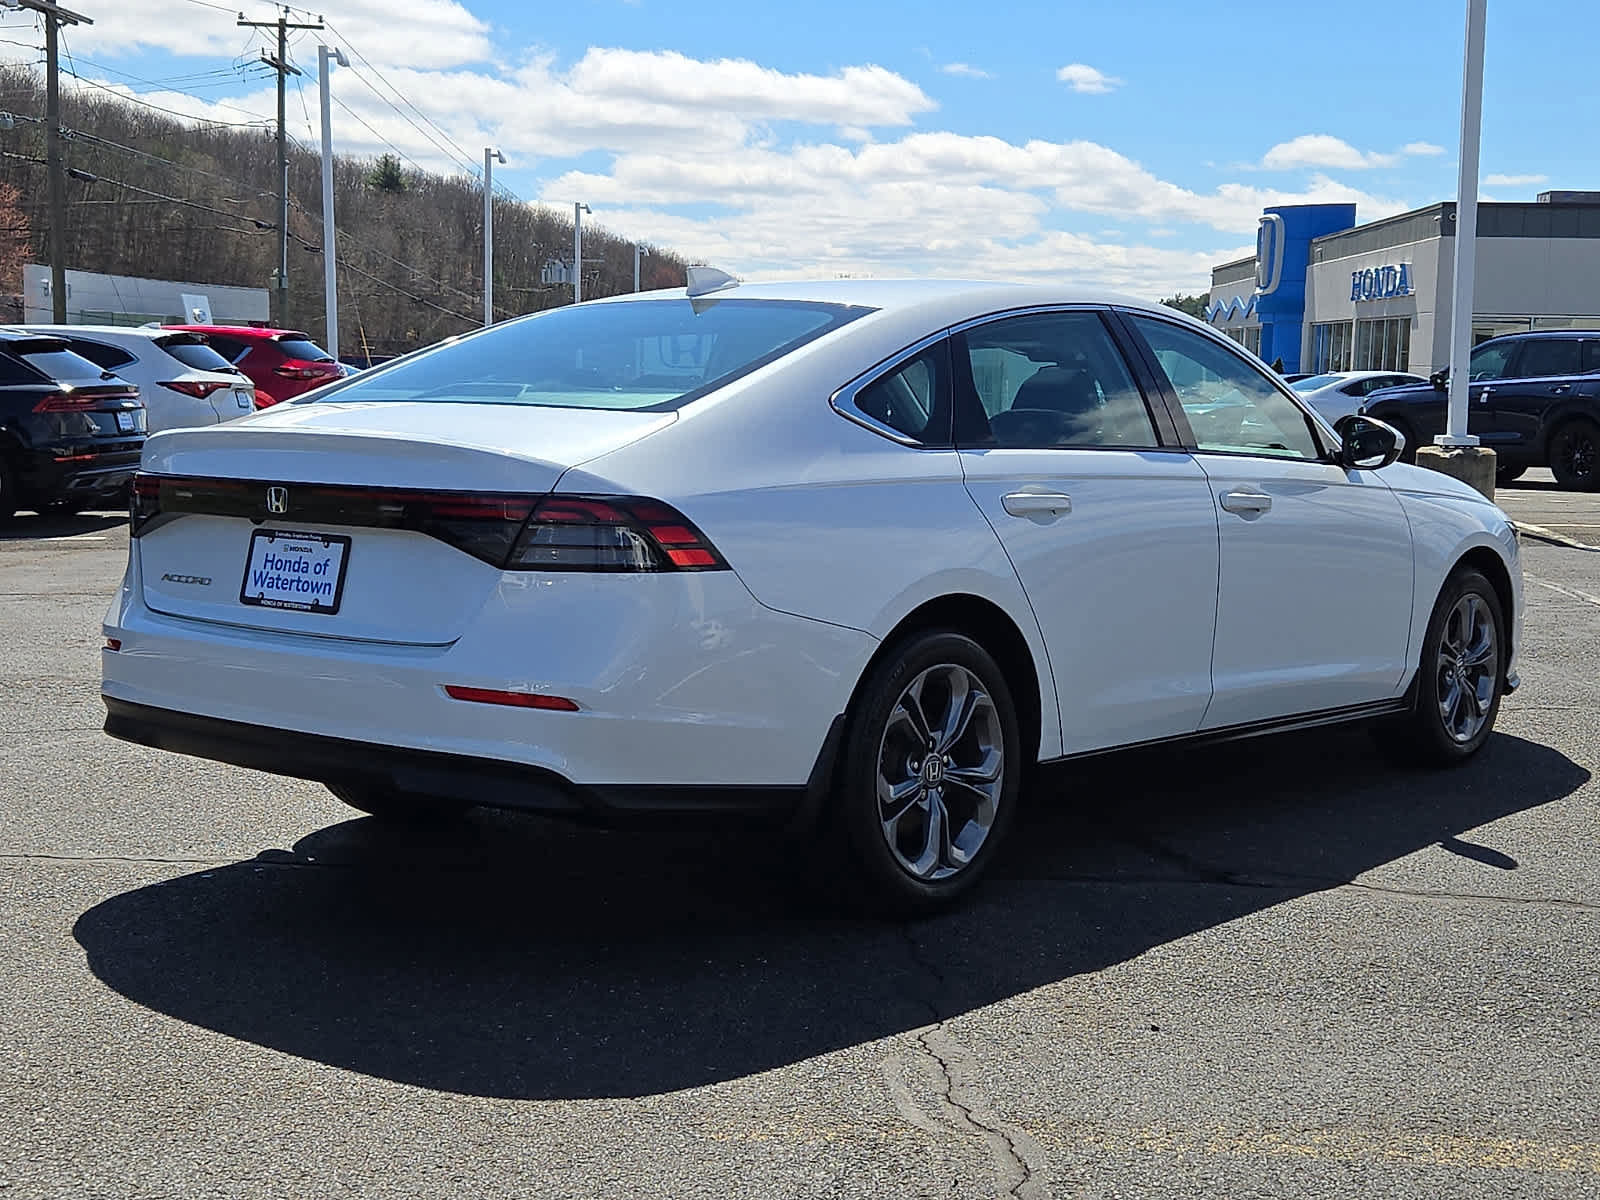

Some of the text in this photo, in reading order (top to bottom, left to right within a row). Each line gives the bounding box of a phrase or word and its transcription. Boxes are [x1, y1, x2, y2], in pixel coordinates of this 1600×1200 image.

[1351, 263, 1414, 301] HONDA
[263, 552, 331, 576] Honda of
[161, 574, 212, 586] ACCORD
[253, 569, 332, 596] Watertown
